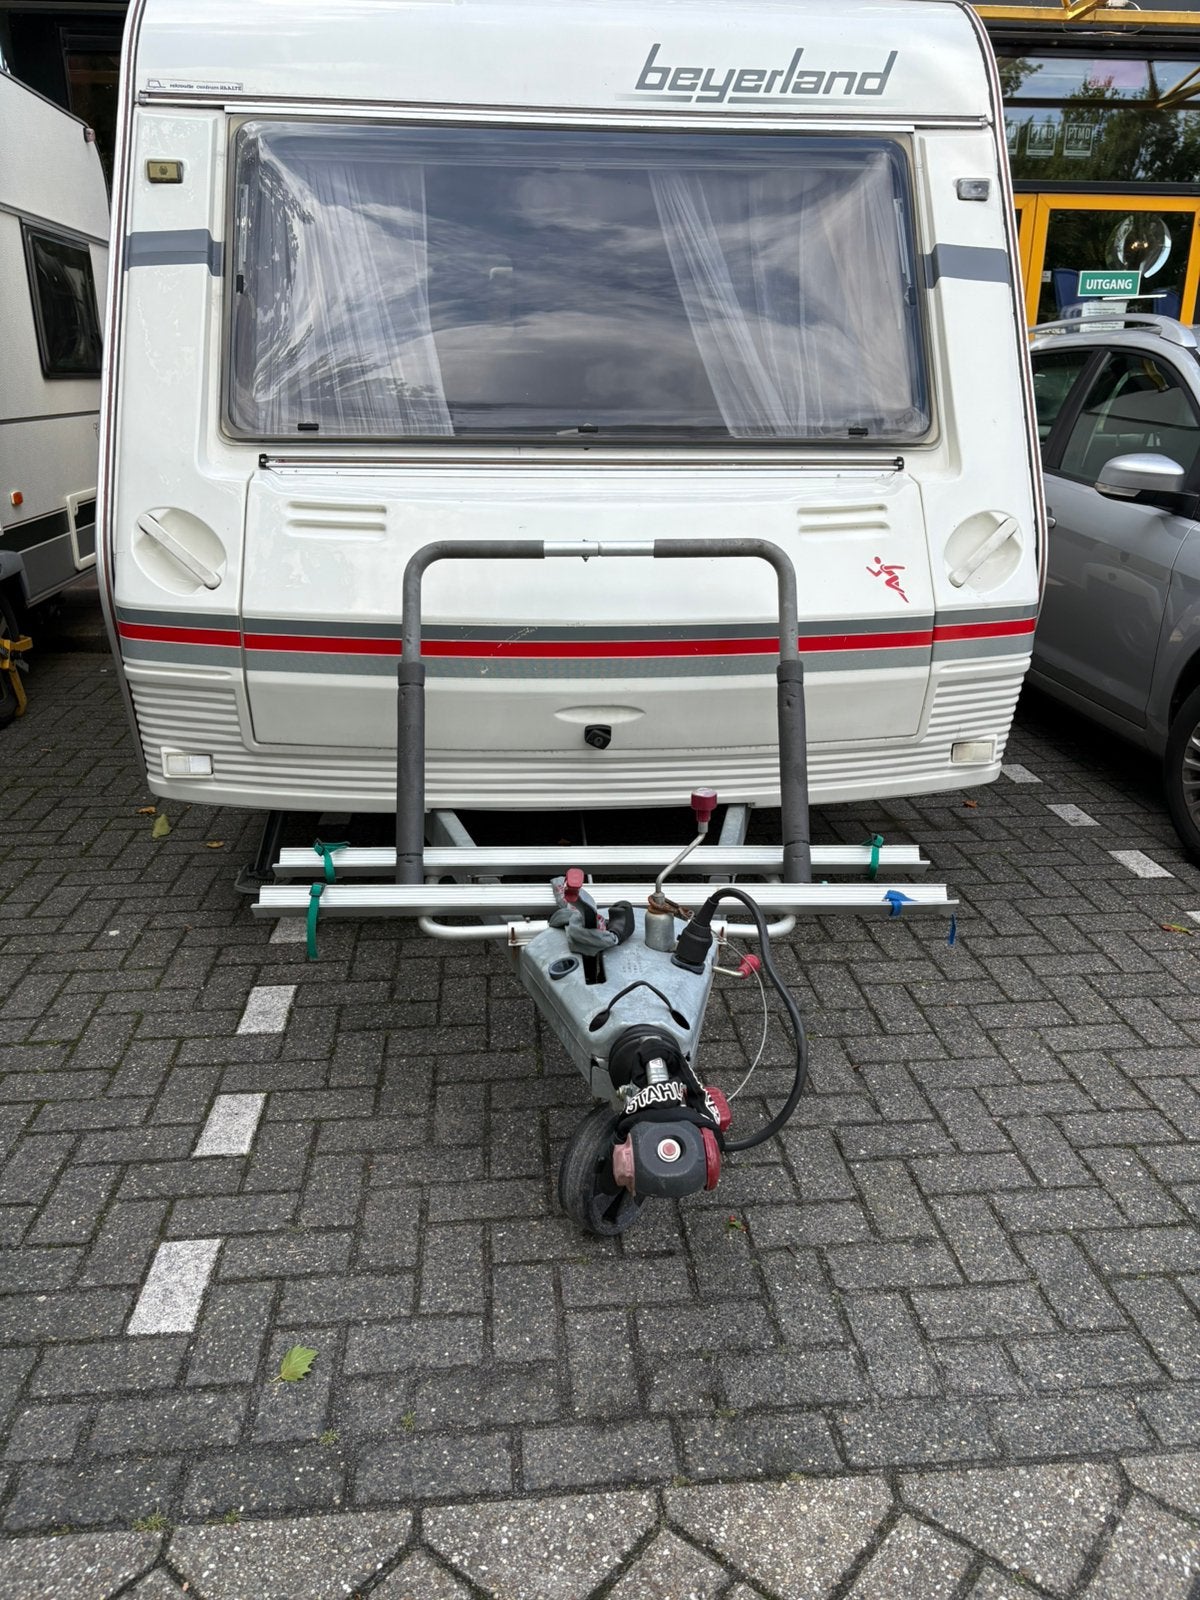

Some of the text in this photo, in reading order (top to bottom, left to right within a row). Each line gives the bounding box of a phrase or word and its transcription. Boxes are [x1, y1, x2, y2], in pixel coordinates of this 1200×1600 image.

[635, 43, 898, 103] beyerland
[1068, 127, 1091, 140] PTMD
[1086, 278, 1133, 290] UITGANG
